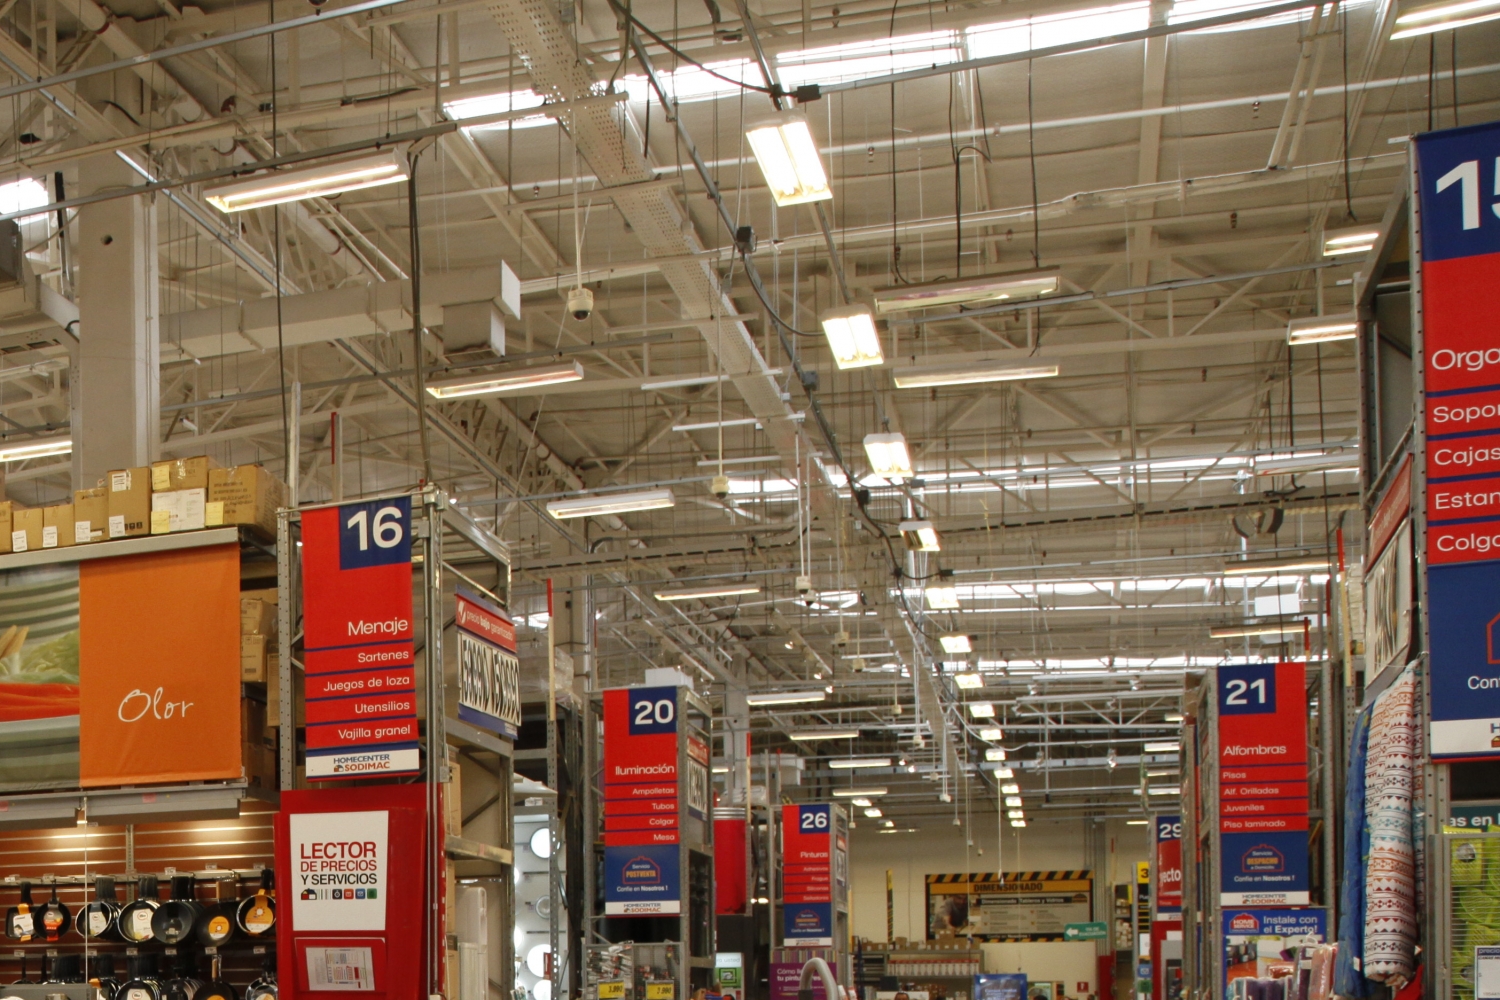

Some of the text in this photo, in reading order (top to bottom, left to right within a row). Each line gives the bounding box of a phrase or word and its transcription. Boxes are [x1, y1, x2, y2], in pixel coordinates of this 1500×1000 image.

[1435, 447, 1500, 467] Cajas
[348, 506, 402, 551] 16
[348, 618, 408, 636] Menaje
[358, 650, 409, 663] Sartenes
[324, 675, 410, 692] Juegos de loza
[1226, 678, 1266, 705] 21
[118, 687, 193, 722] Olor
[355, 700, 410, 714] Utensilios
[634, 699, 674, 725] 20
[338, 724, 410, 740] Vajilla granel
[1223, 744, 1286, 756] Alfombras
[333, 754, 390, 764] HOMECENTER
[344, 762, 390, 772] SODIMAC
[615, 764, 674, 776] Iluminación
[1223, 771, 1246, 779] Pisos
[1240, 786, 1279, 795] Orilladas
[1224, 804, 1264, 812] Juveniles
[650, 818, 674, 826] Colgar
[802, 812, 827, 828] 26
[1224, 820, 1286, 829] Piso laminado
[300, 842, 377, 860] LECTOR
[301, 860, 377, 872] DE PRECIOS
[301, 873, 377, 885] Y SERVICIOS
[974, 883, 1043, 892] DIMENSIONADO
[1264, 916, 1296, 924] Instale
[1275, 926, 1317, 934] Experto!
